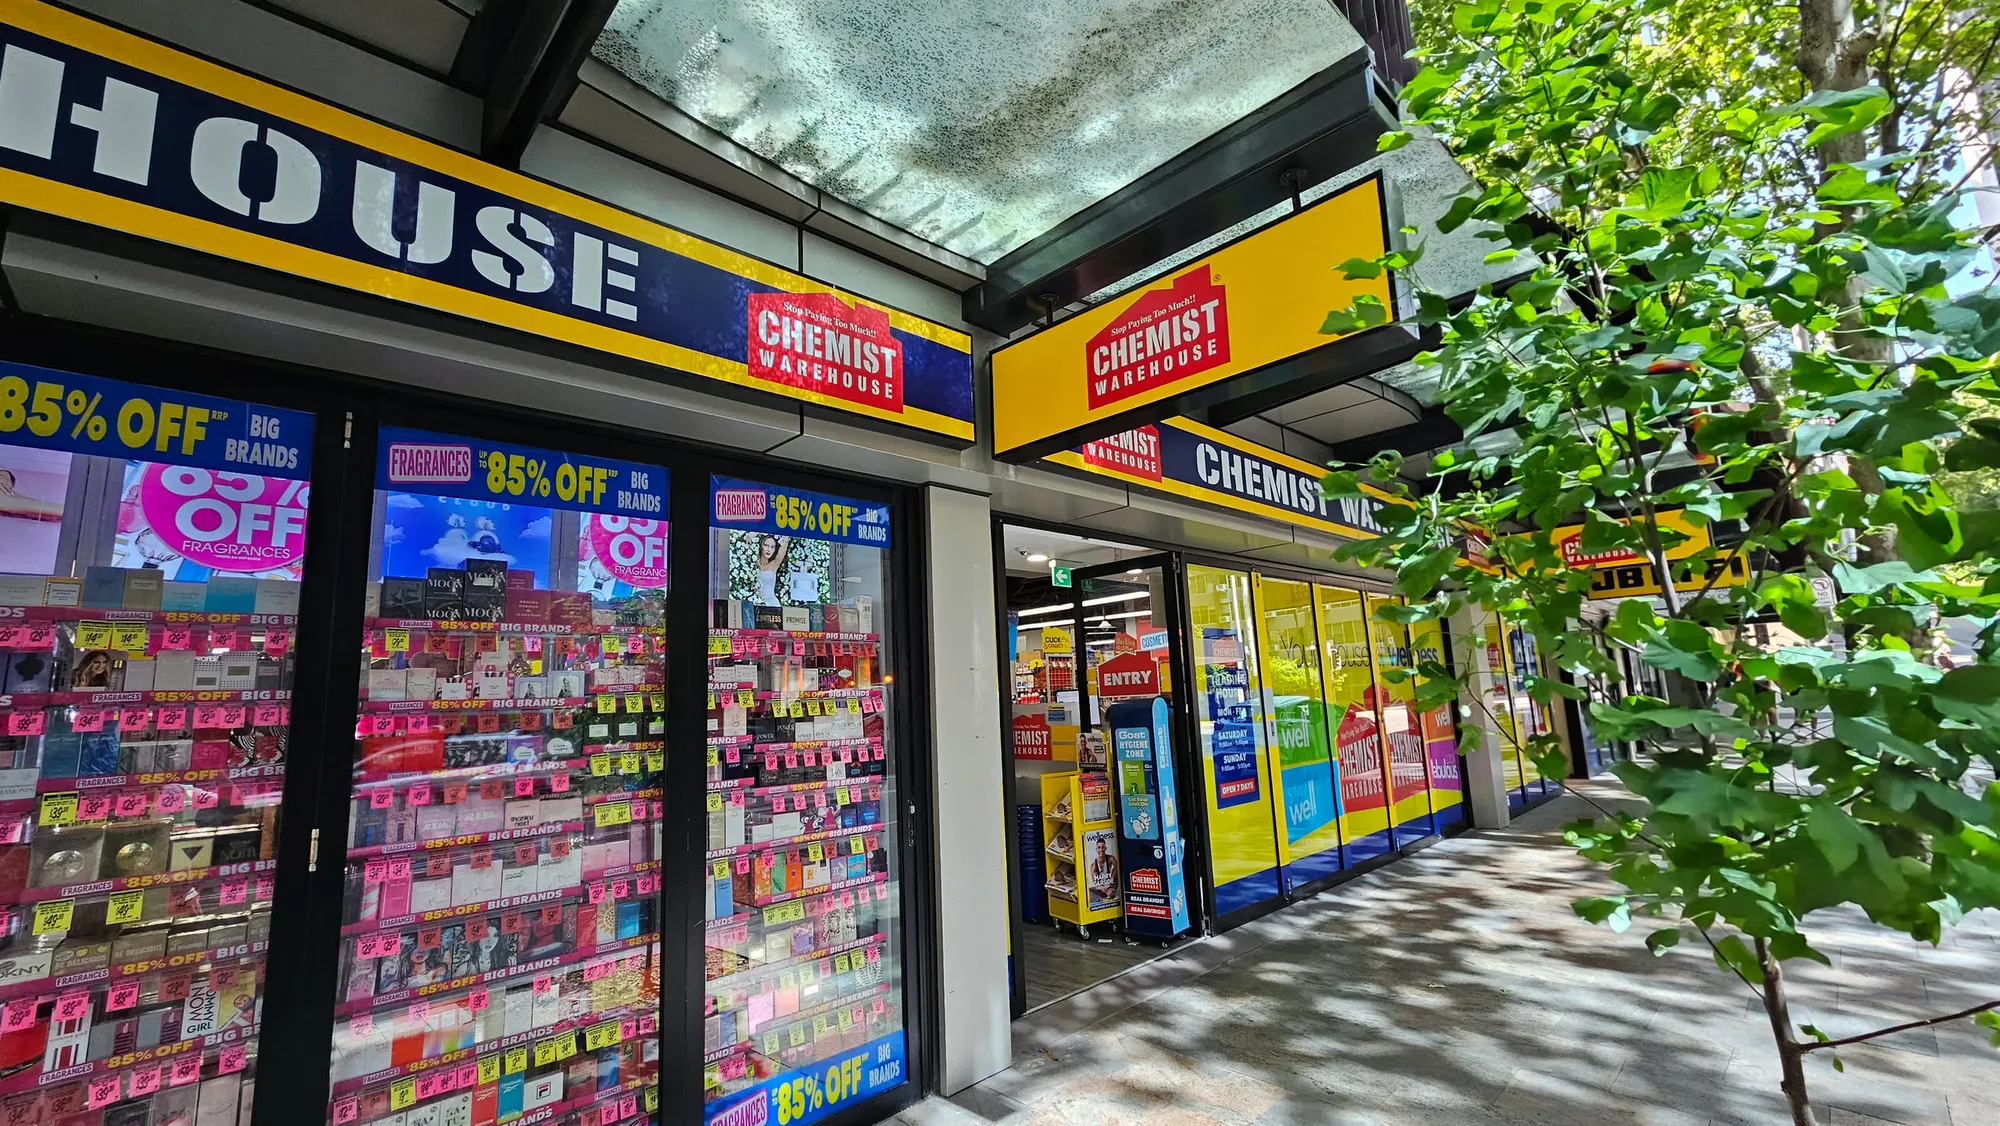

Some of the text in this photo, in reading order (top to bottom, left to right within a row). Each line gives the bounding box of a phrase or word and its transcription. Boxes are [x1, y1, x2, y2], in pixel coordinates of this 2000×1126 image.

[0, 43, 641, 322] HOUSE
[784, 301, 877, 340] Stop Paying Too Much!!
[1110, 294, 1197, 338] Stop Paying Too Much!!
[758, 310, 897, 379] CHEMIST
[1093, 298, 1219, 376] CHEMIST
[759, 348, 894, 399] WAREHOUSE
[1095, 338, 1218, 397] WAREHOUSE
[0, 376, 229, 455] 85% OFF RRP
[249, 414, 281, 440] BIG
[225, 438, 299, 469] BRANDS
[479, 450, 488, 459] UP
[1098, 429, 1156, 458] EMIST
[391, 448, 470, 478] FRAGRANCES
[1087, 442, 1157, 473] WAREHOUSE
[487, 451, 550, 498] 85%
[556, 463, 608, 506] OFF
[608, 469, 619, 479] RRP
[630, 470, 649, 490] BIG
[1196, 443, 1329, 516] CHEMIST
[618, 490, 661, 513] BRANDS
[717, 494, 765, 516] FRAGRANCES
[175, 498, 305, 548] OFF
[775, 495, 816, 532] 85%
[818, 503, 852, 537] OFF
[865, 508, 879, 523] BIG
[857, 524, 887, 542] BRANDS
[183, 540, 291, 559] FRAGRANCES
[1567, 547, 1634, 564] WAREHOUSE
[1591, 566, 1644, 591] JB
[106, 612, 280, 625] FRAGRANCES 85% OFF BIG
[399, 620, 571, 633] FRAGRANCES 85% OFF BIG BRANDS
[786, 616, 806, 624] PROMISE
[1104, 670, 1152, 686] ENTRY
[93, 690, 272, 702] FRAGRANCES 85% OFF BIG
[432, 700, 460, 709] 85%
[462, 700, 486, 708] OFF
[492, 699, 515, 708] BIG
[516, 698, 565, 707] BRANDS
[1014, 730, 1048, 745] EMIST
[1119, 731, 1146, 740] Goat
[1218, 729, 1248, 741] SATURDAY
[1281, 711, 1310, 749] well
[1120, 740, 1148, 749] HYGIENE
[1126, 750, 1144, 758] ZONE
[1223, 753, 1247, 764] SUNDAY
[77, 767, 261, 788] FRAGRANCES 85% OFF BIG
[809, 782, 824, 790] OFF
[827, 779, 840, 788] BIG
[840, 776, 870, 786] BRANDS
[1222, 780, 1254, 796] OPEN 7 DAYS
[1342, 776, 1383, 800] AREHOUSE
[1289, 780, 1317, 826] well
[382, 824, 562, 854] FRAGRANCES 85% OFF BIG BRANDS
[811, 832, 826, 842] OFF
[828, 830, 842, 839] BIG
[842, 825, 873, 836] BRANDS
[62, 863, 250, 896] FRAGRANCES 85% OFF BIG
[1132, 875, 1159, 885] CHEMIST
[380, 889, 563, 928] FRAGRANCES 85% OFF BIG BRANDS
[203, 989, 216, 1021] OMMY
[187, 1022, 213, 1033] GIRL
[877, 1042, 891, 1062] BIG
[869, 1060, 900, 1088] BRANDS
[777, 1056, 863, 1125] 85% OFF
[712, 1096, 766, 1126] AGRANCES
